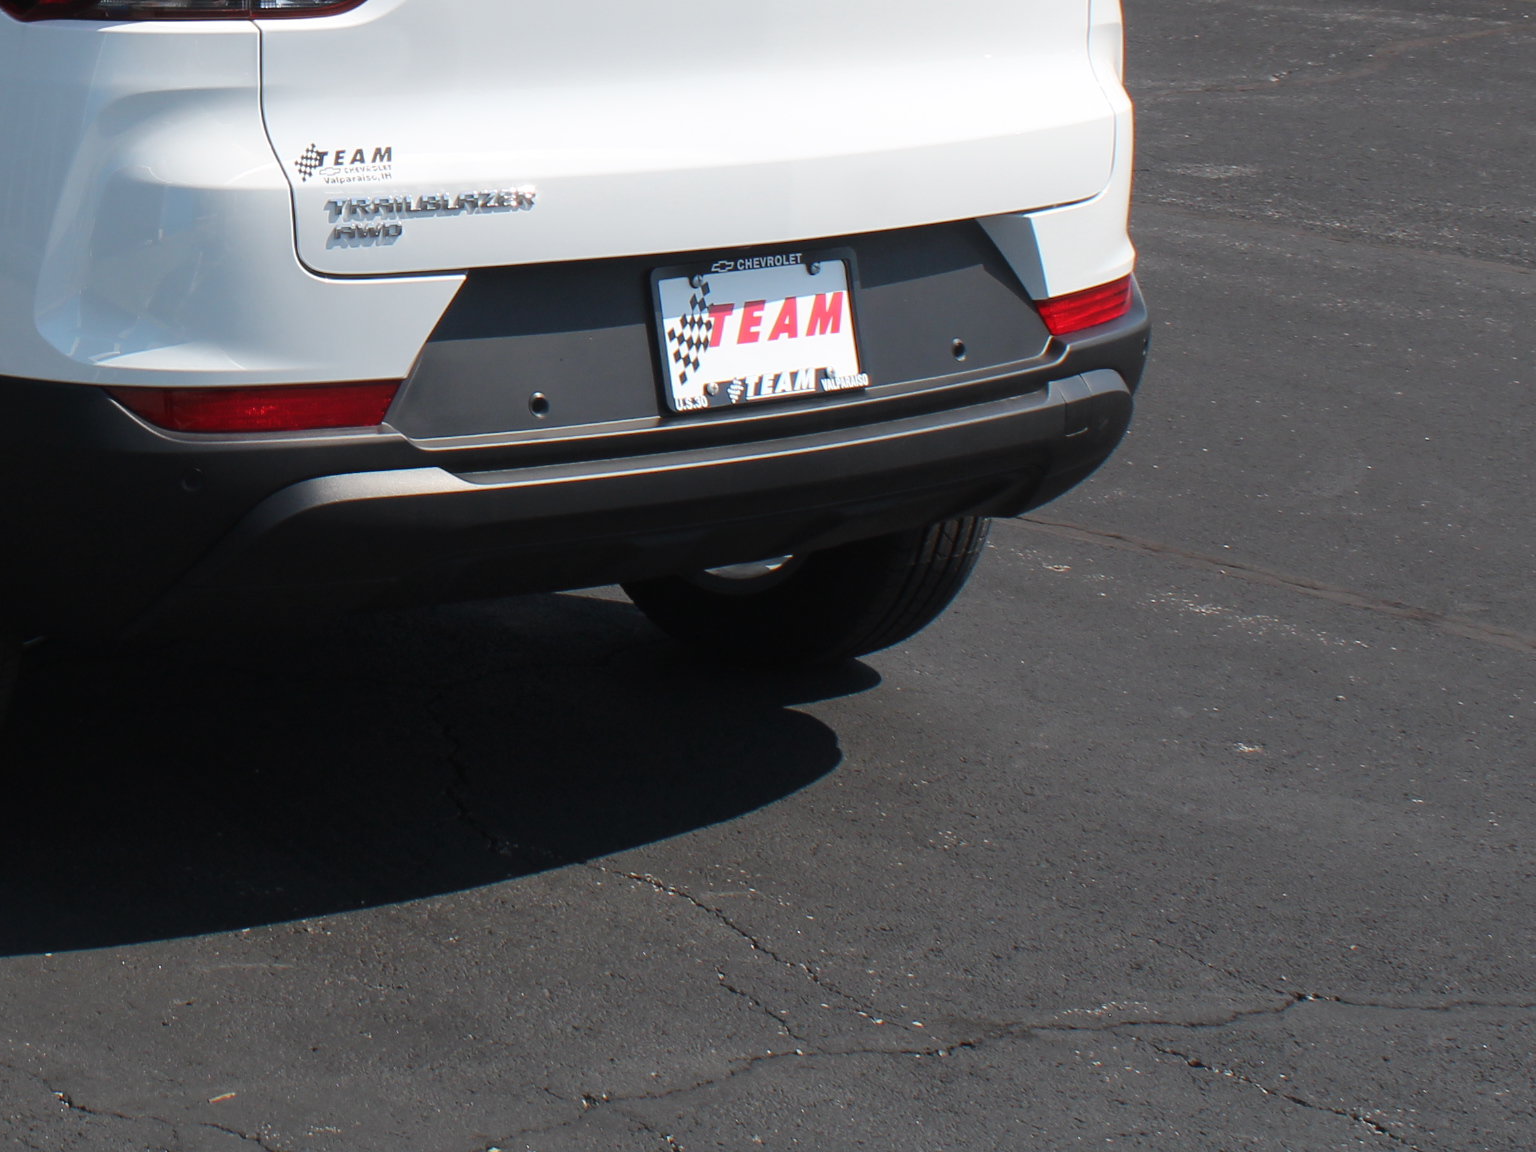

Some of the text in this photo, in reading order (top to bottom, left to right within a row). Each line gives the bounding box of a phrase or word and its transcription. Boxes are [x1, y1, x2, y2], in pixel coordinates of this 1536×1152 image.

[317, 146, 392, 167] TEAM
[327, 188, 536, 219] TRAILBLAZER
[331, 221, 404, 242] AWD
[736, 253, 803, 270] CHEVROLET
[707, 291, 844, 348] TEAM
[745, 368, 816, 398] TEAM
[821, 373, 869, 392] VALPARAISO
